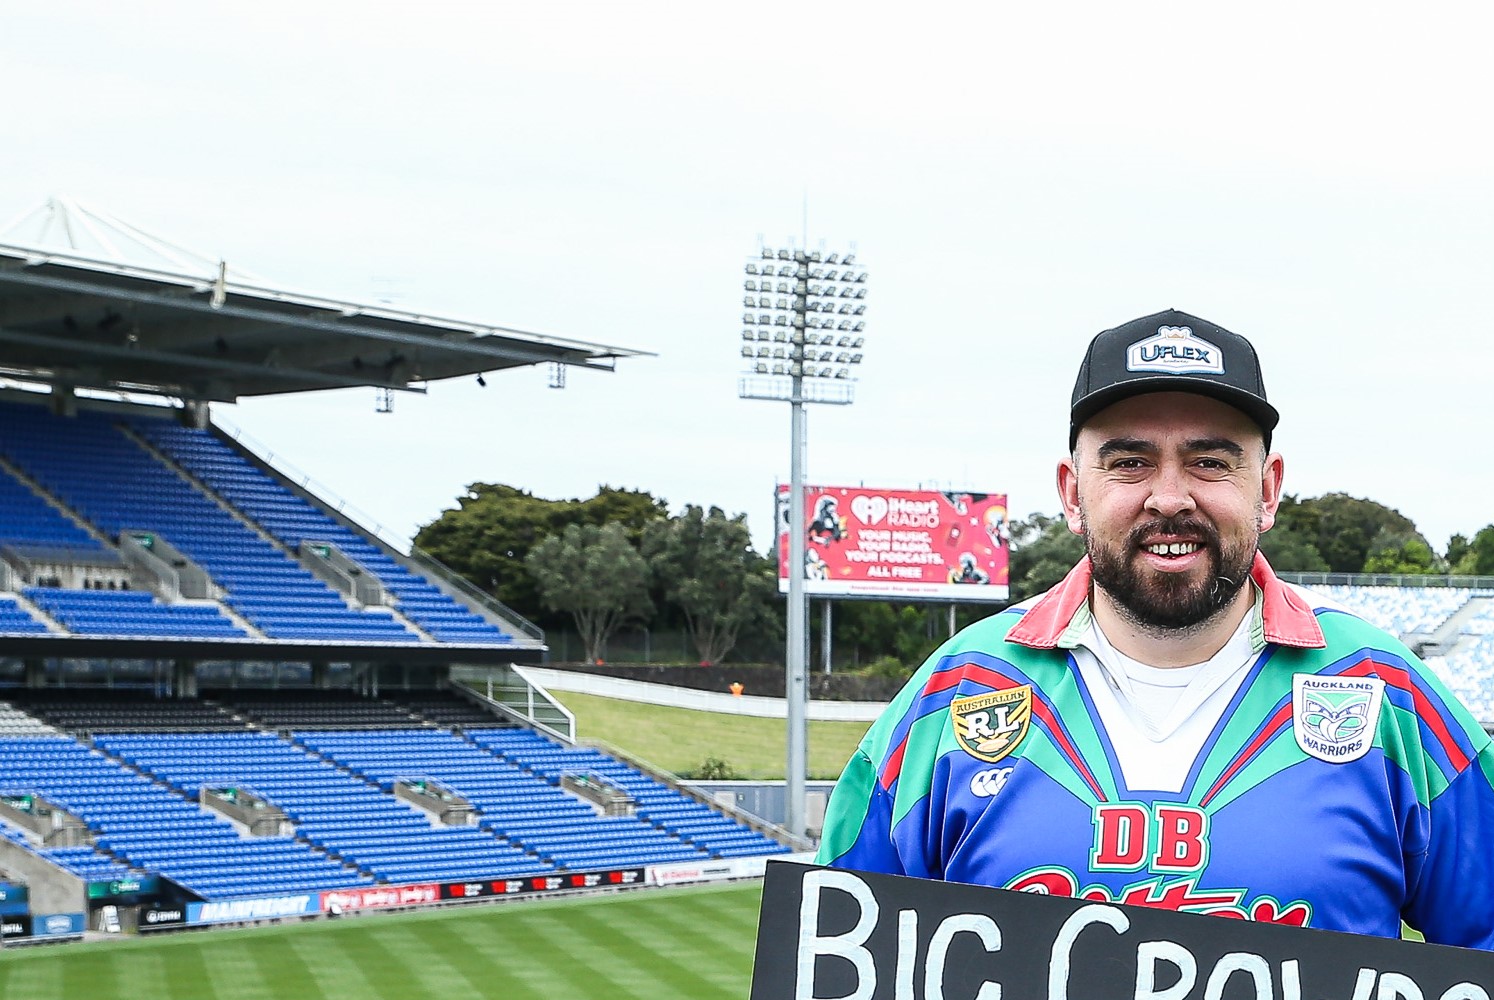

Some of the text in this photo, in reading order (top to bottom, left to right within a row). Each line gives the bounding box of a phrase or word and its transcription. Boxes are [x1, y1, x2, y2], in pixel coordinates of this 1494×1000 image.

[1141, 345, 1210, 363] UFLEX
[887, 497, 939, 514] iHeart
[887, 512, 940, 528] RADIO
[858, 529, 891, 541] YOUR
[857, 540, 891, 551] YOUR
[845, 550, 879, 562] YOUR
[867, 565, 922, 578] ALL FREE
[1302, 680, 1373, 690] AUCKLAND
[956, 691, 1025, 713] AUSTRALIAN
[965, 706, 1023, 739] RL
[1303, 734, 1363, 756] WARRIORS
[1093, 804, 1207, 872] DB
